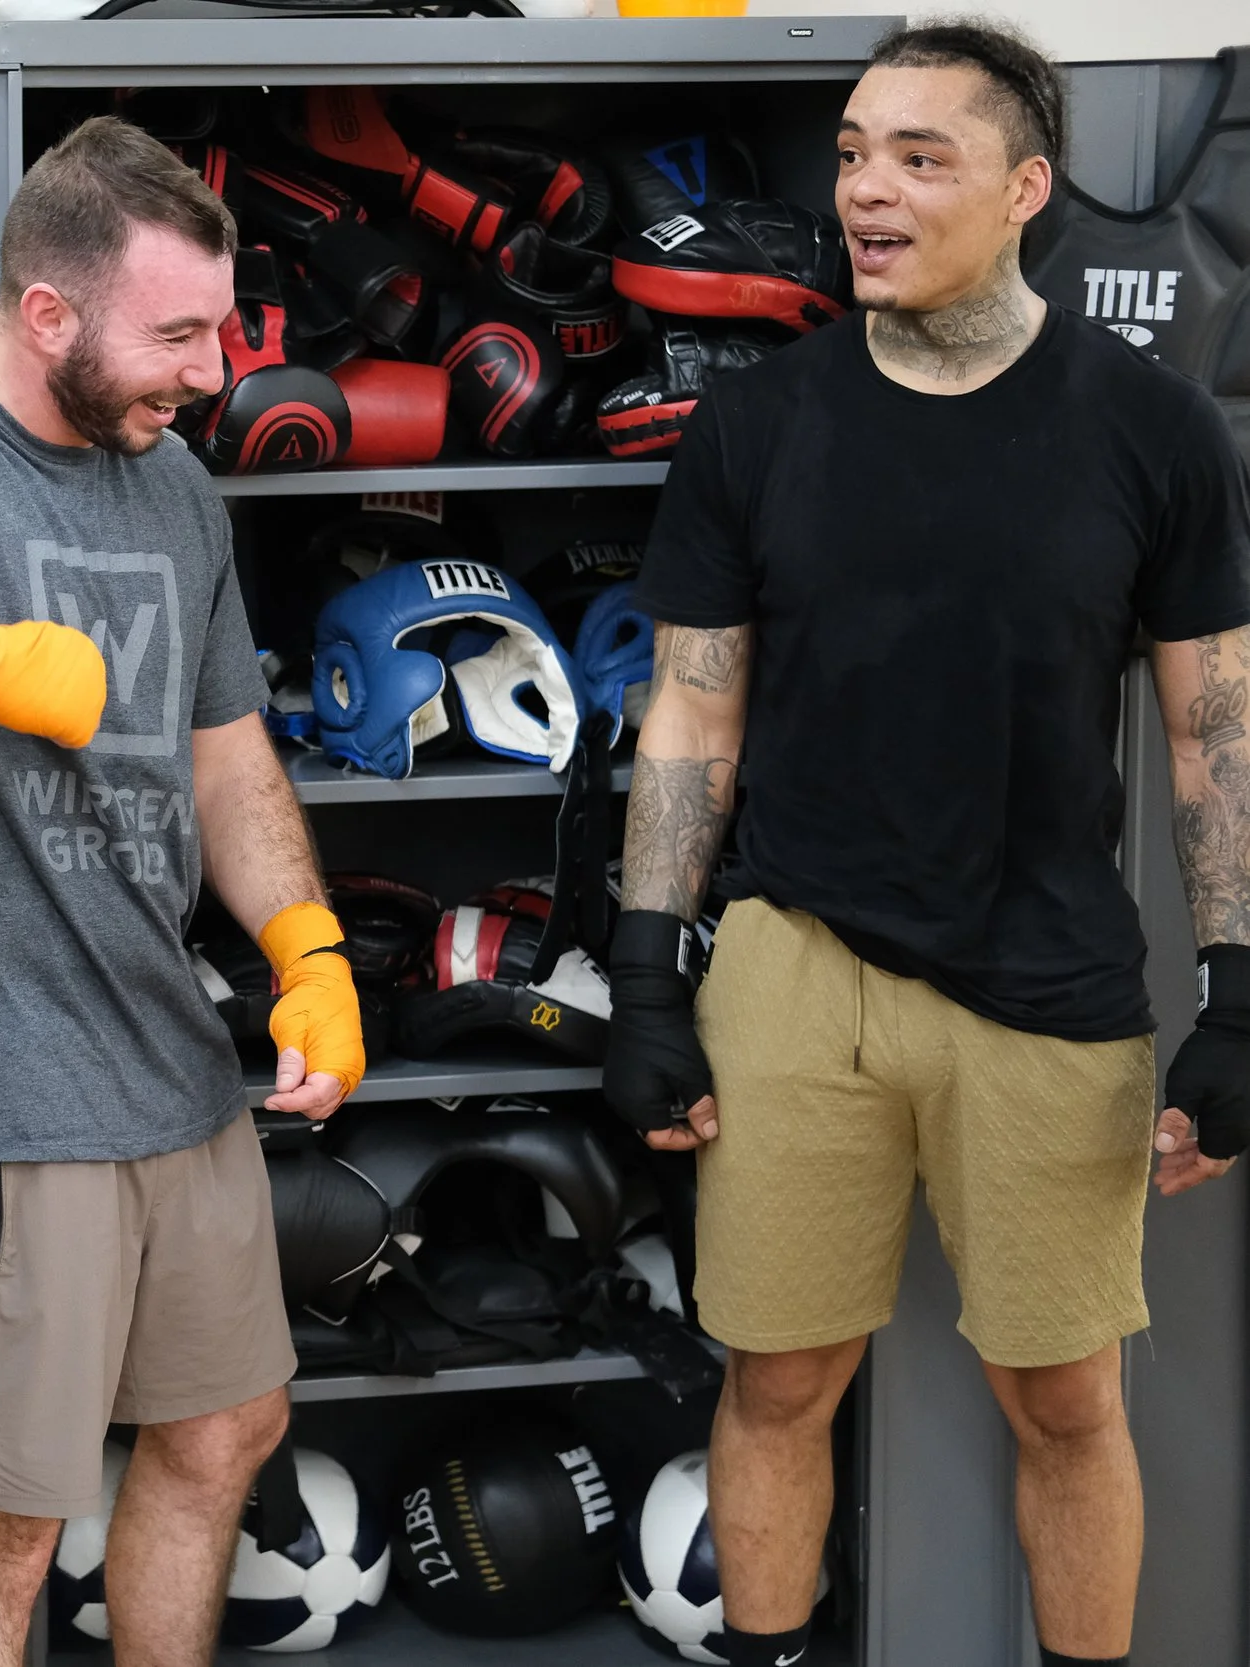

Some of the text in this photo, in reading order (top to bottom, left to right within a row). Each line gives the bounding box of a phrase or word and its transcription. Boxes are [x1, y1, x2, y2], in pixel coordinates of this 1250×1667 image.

[1083, 268, 1177, 321] TITLE
[426, 564, 504, 593] TITLE
[565, 543, 645, 575] EVERLA
[556, 1446, 615, 1535] TITLE
[403, 1487, 460, 1589] 12 LBS
